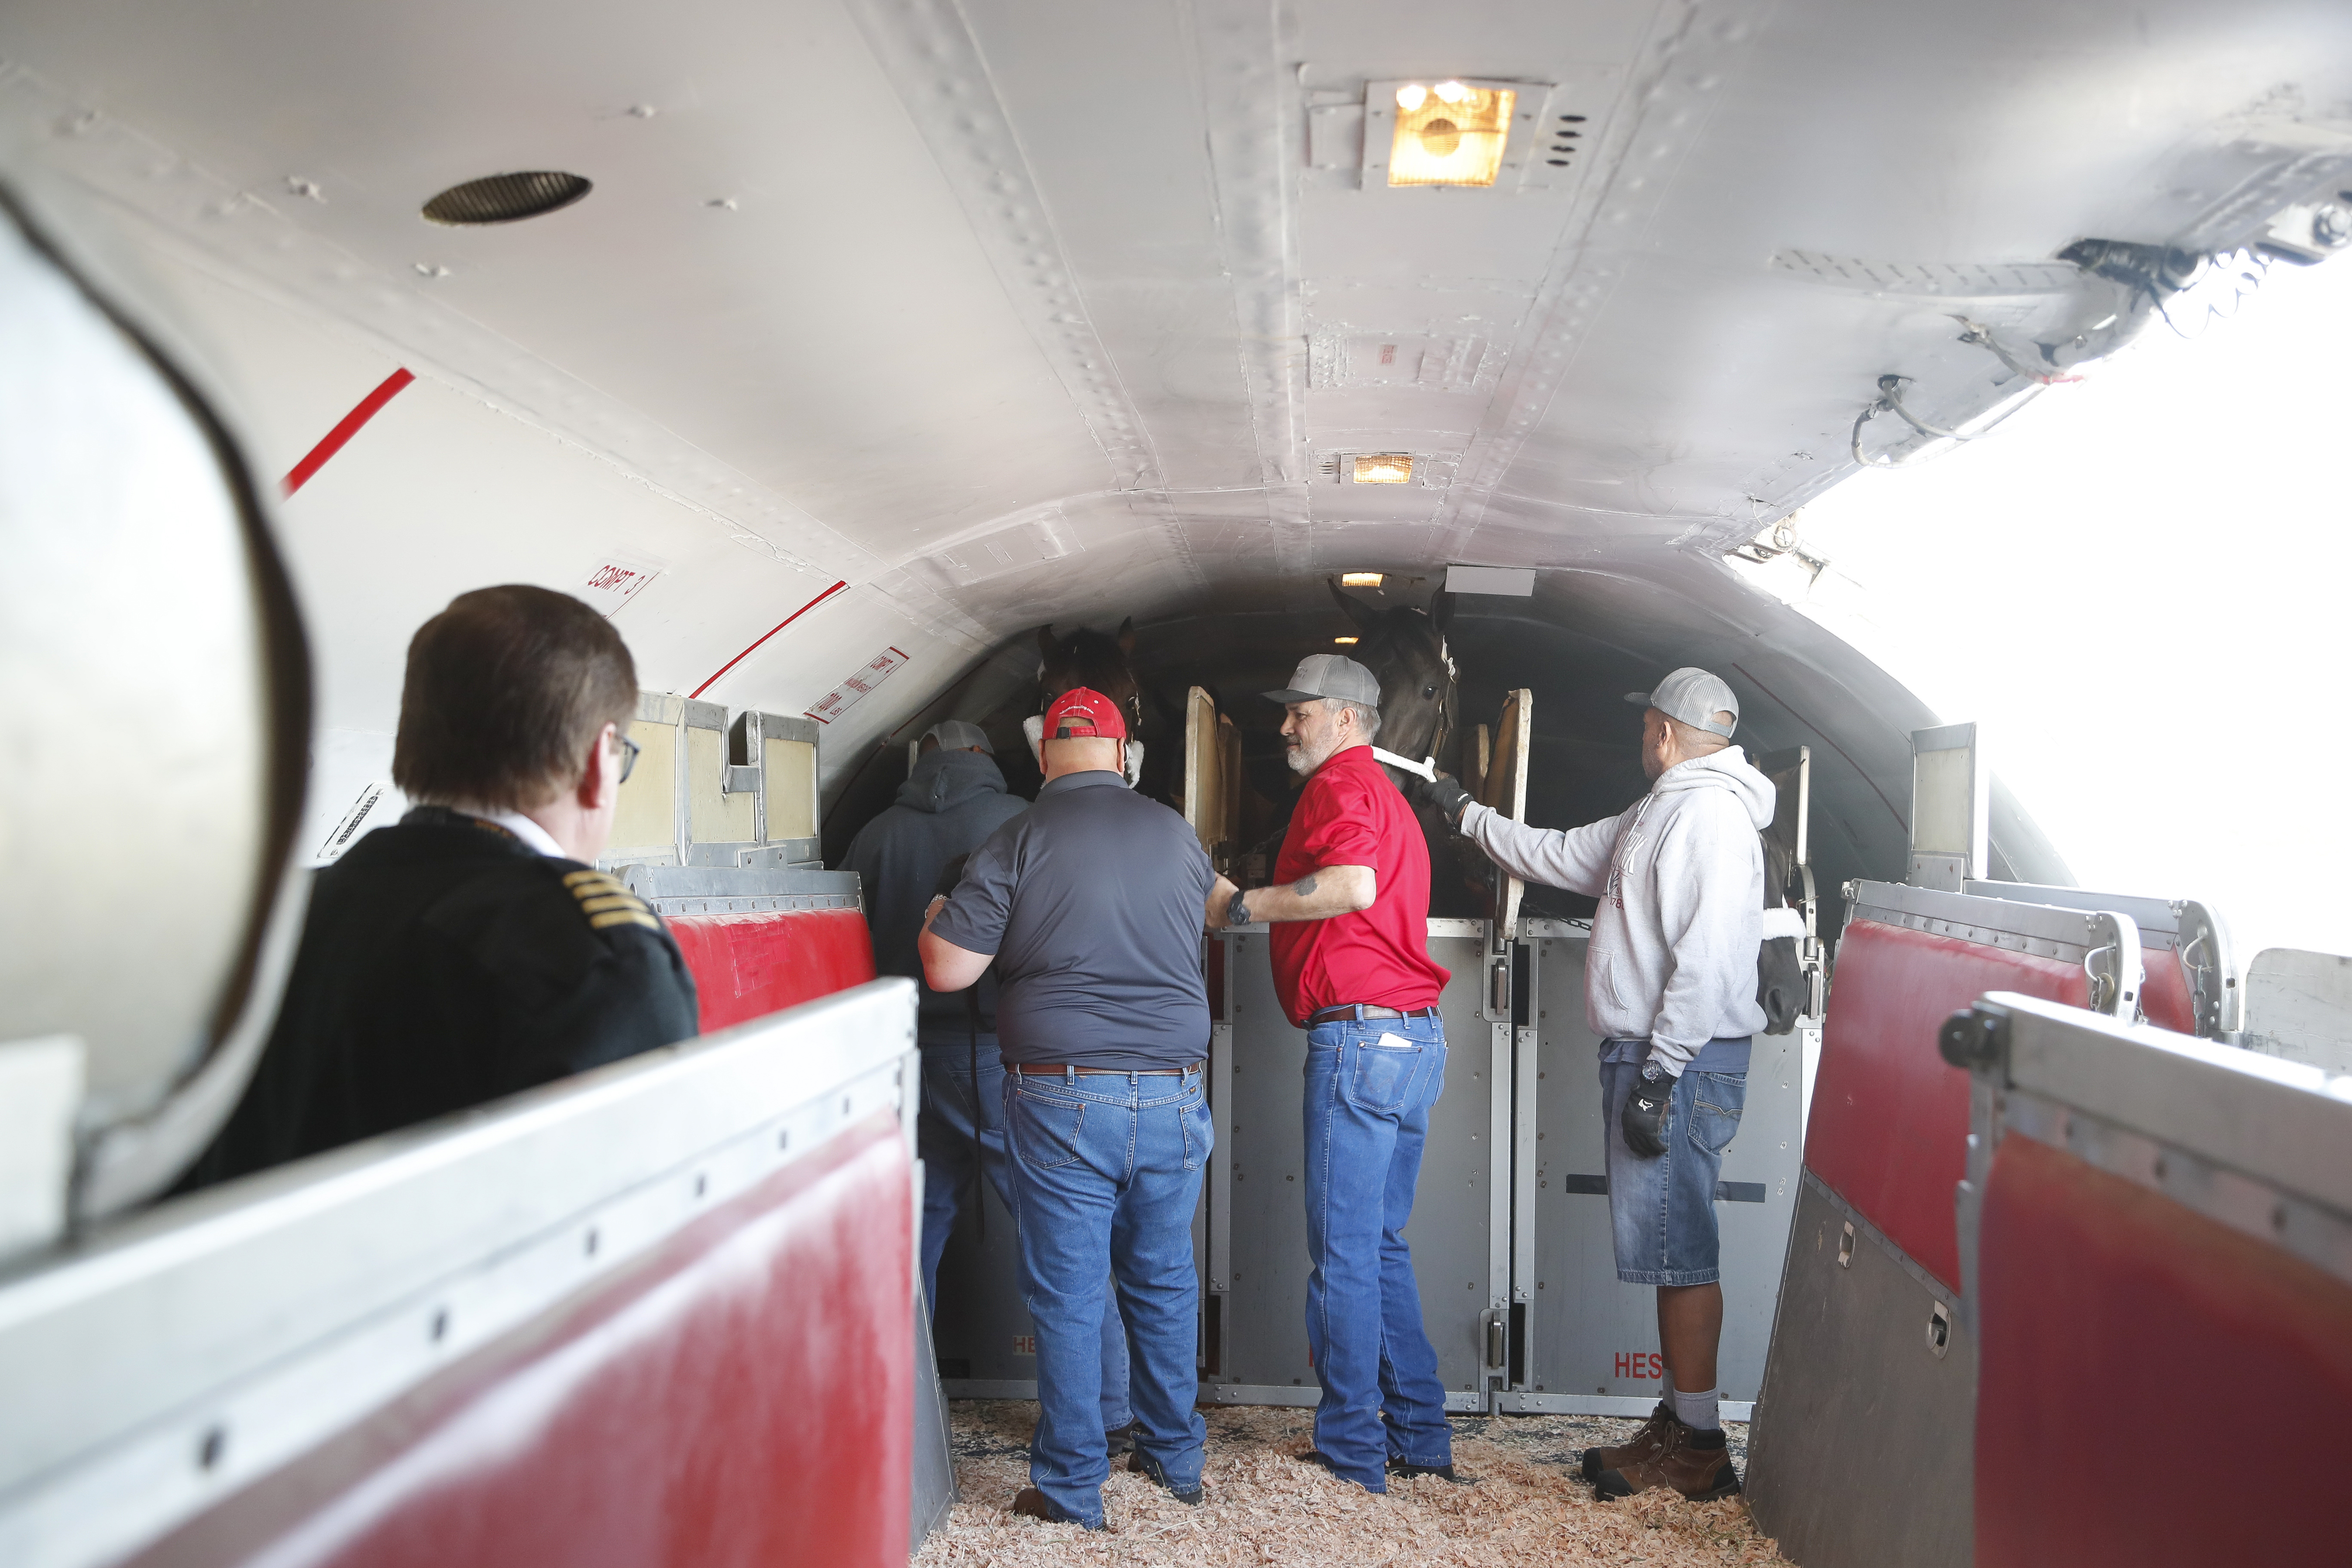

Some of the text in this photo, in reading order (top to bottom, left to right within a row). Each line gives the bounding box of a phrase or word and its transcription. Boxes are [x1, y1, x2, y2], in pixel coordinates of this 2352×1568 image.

[588, 565, 646, 595] COMPT 3
[870, 655, 894, 672] COMPT
[1615, 1352, 1662, 1379] HES
